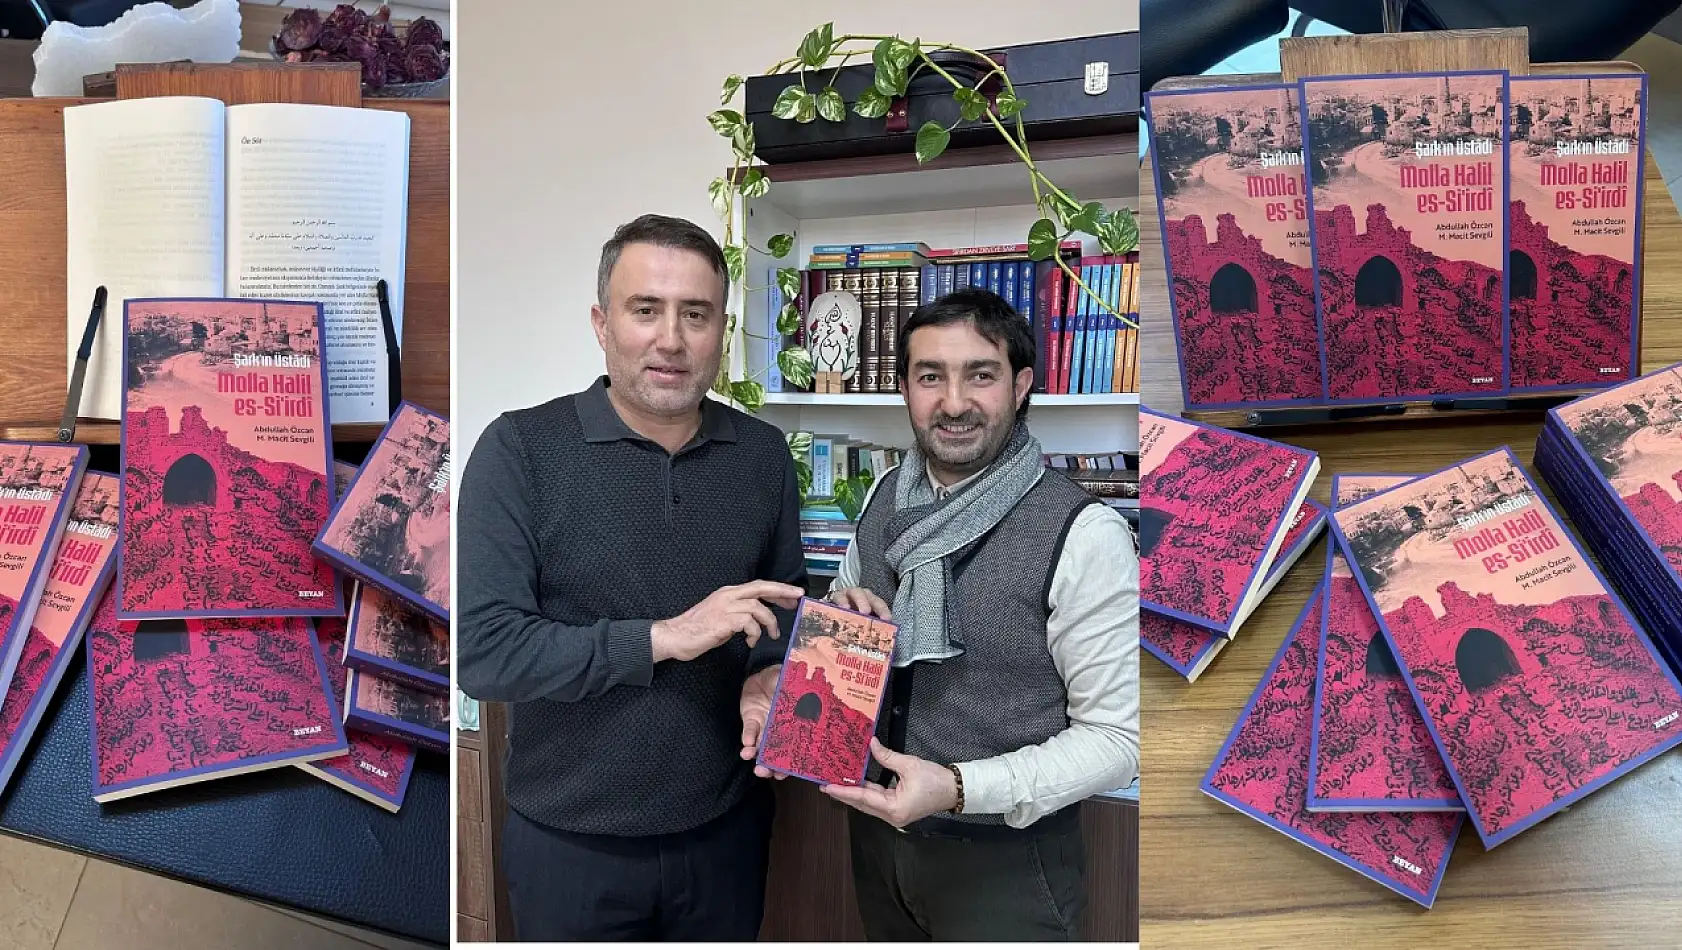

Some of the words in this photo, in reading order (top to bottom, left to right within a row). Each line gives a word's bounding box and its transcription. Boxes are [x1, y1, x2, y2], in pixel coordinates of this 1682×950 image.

[1400, 164, 1450, 188] Molla
[1454, 162, 1492, 186] Halil
[1540, 161, 1588, 186] Molla
[1592, 160, 1628, 184] Halil
[1247, 173, 1298, 197] Molla
[1436, 222, 1469, 231] Abdullah
[1470, 220, 1494, 229] Özcan
[218, 372, 268, 393] Molla
[272, 374, 312, 394] Halil
[254, 426, 290, 434] Abdullah
[290, 425, 314, 434] Özcan
[4, 505, 46, 525] Halil
[1453, 528, 1508, 560] Molla
[1502, 508, 1546, 539] Halil
[61, 539, 104, 565] Halil
[1515, 564, 1549, 583] Abdullah
[1547, 556, 1571, 568] Özcan
[1552, 563, 1577, 578] Sevgili
[298, 590, 324, 598] BEYAN
[293, 726, 322, 736] BEYAN
[360, 760, 388, 778] BEYAN
[1392, 854, 1422, 875] BEYAN
